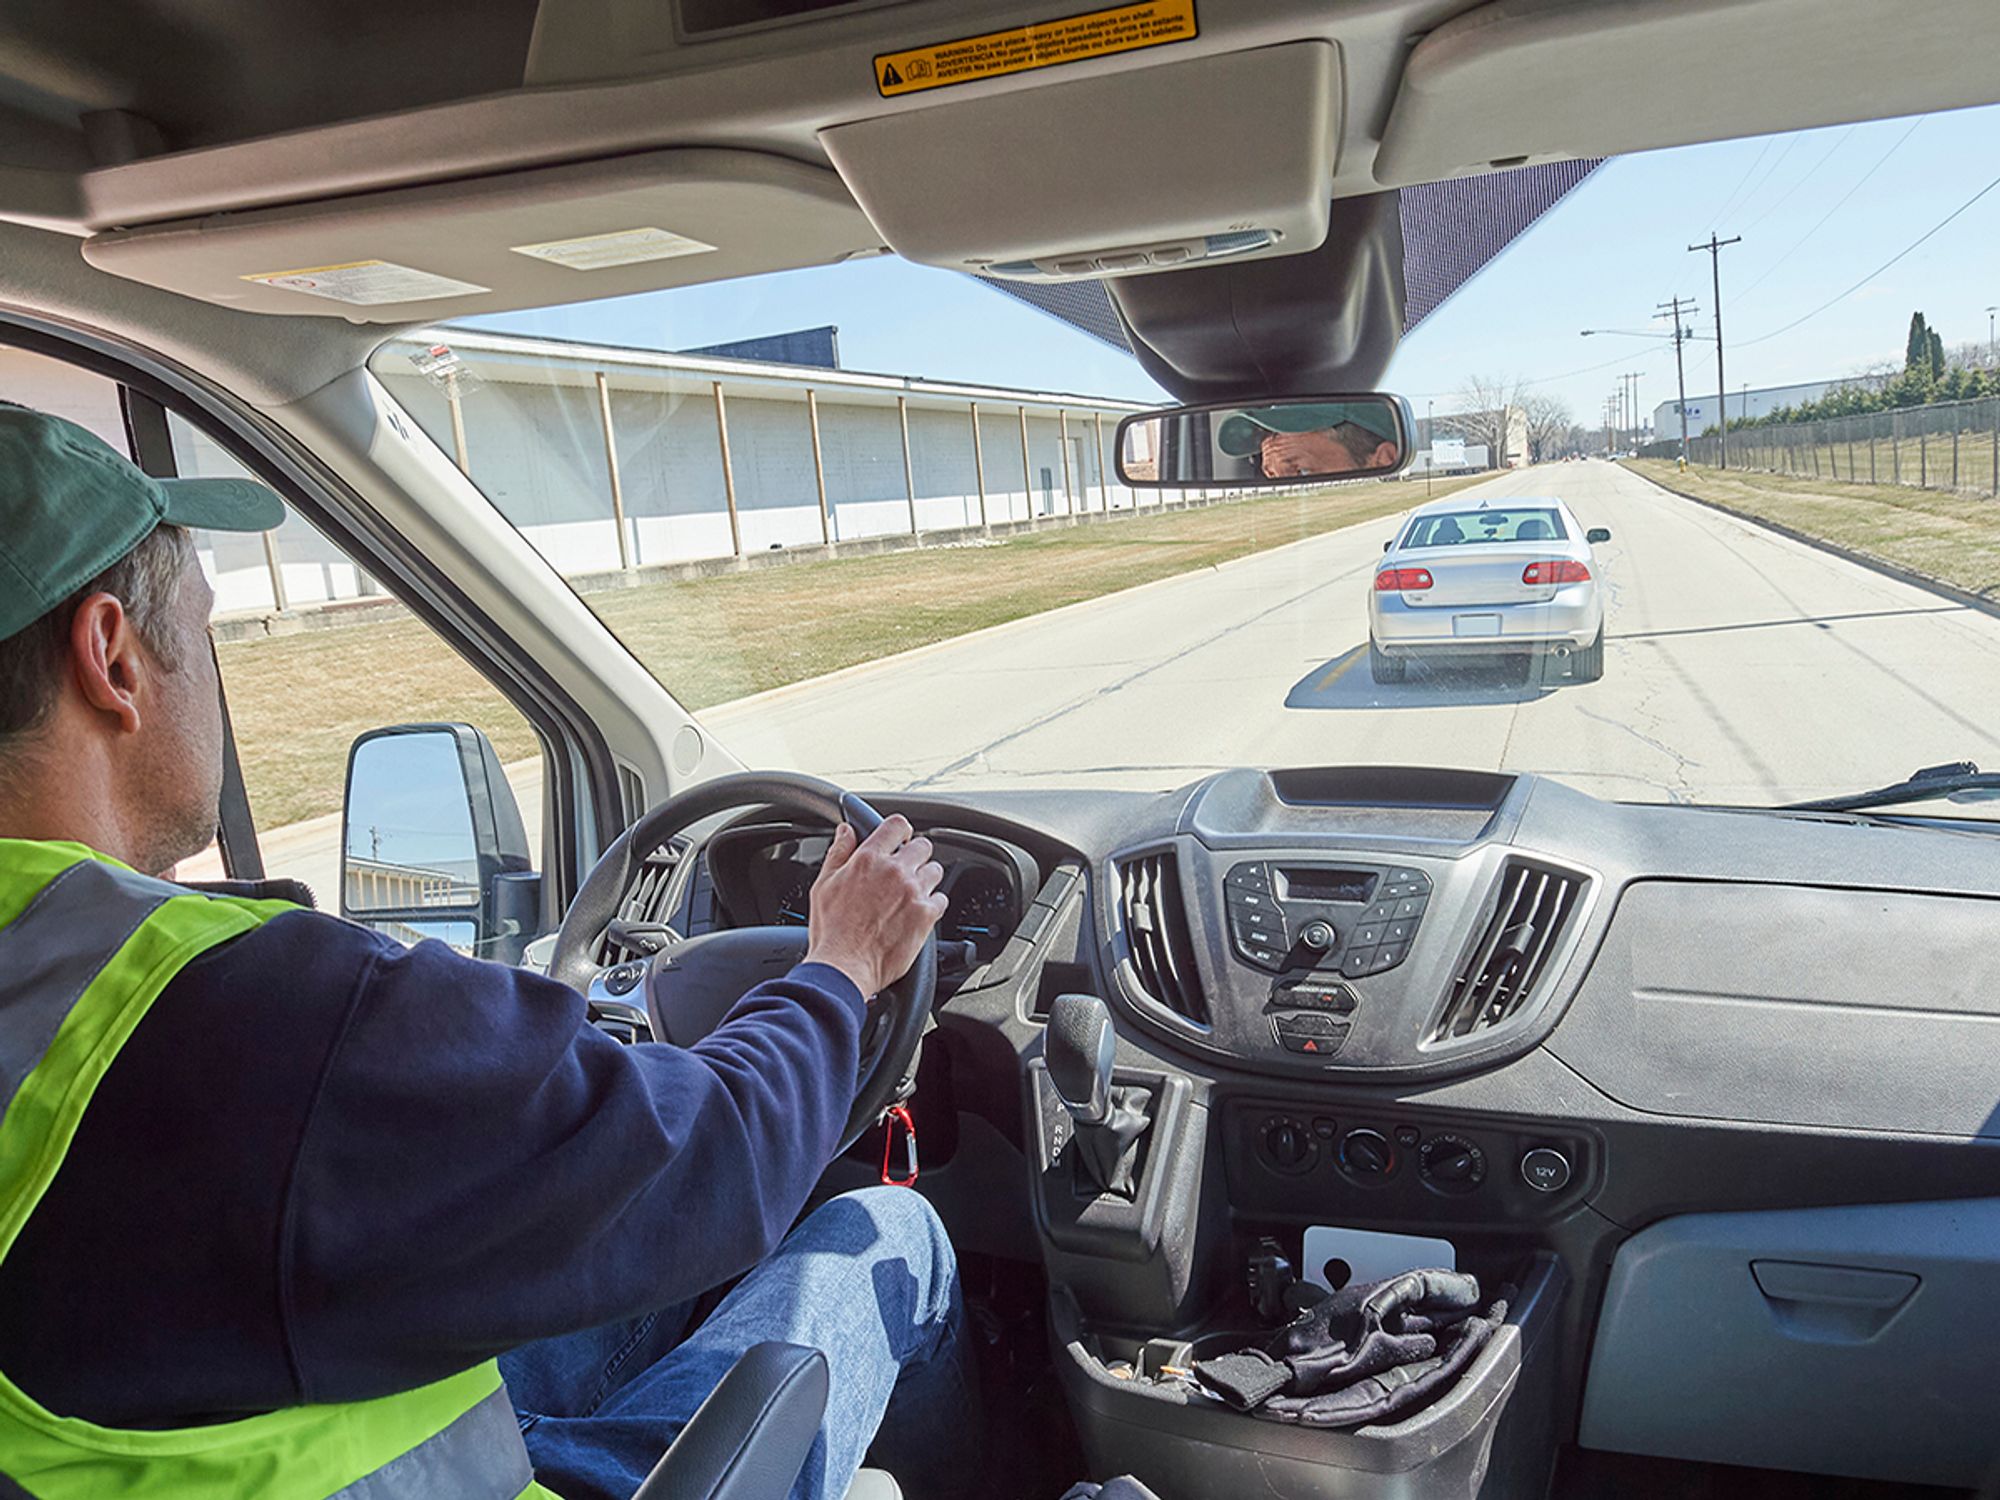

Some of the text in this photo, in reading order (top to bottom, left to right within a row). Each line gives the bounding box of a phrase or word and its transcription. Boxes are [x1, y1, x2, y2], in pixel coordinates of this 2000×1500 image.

[934, 46, 974, 59] WARNING
[975, 43, 987, 51] Do
[989, 40, 1002, 48] not
[1004, 36, 1025, 47] place
[1026, 31, 1051, 42] eavy
[1065, 24, 1084, 33] hard
[1086, 17, 1116, 30] objects
[935, 51, 994, 69] ADVERTENCIA
[995, 49, 1007, 57] No
[1067, 30, 1102, 44] pesados
[1112, 23, 1137, 33] duros
[937, 65, 971, 77] AVERTIR
[986, 61, 1001, 69] pas
[1104, 36, 1123, 46] durs
[1057, 1103, 1065, 1112] P
[1055, 1124, 1063, 1134] R
[1053, 1136, 1061, 1145] N
[1535, 1167, 1556, 1177] 12V
